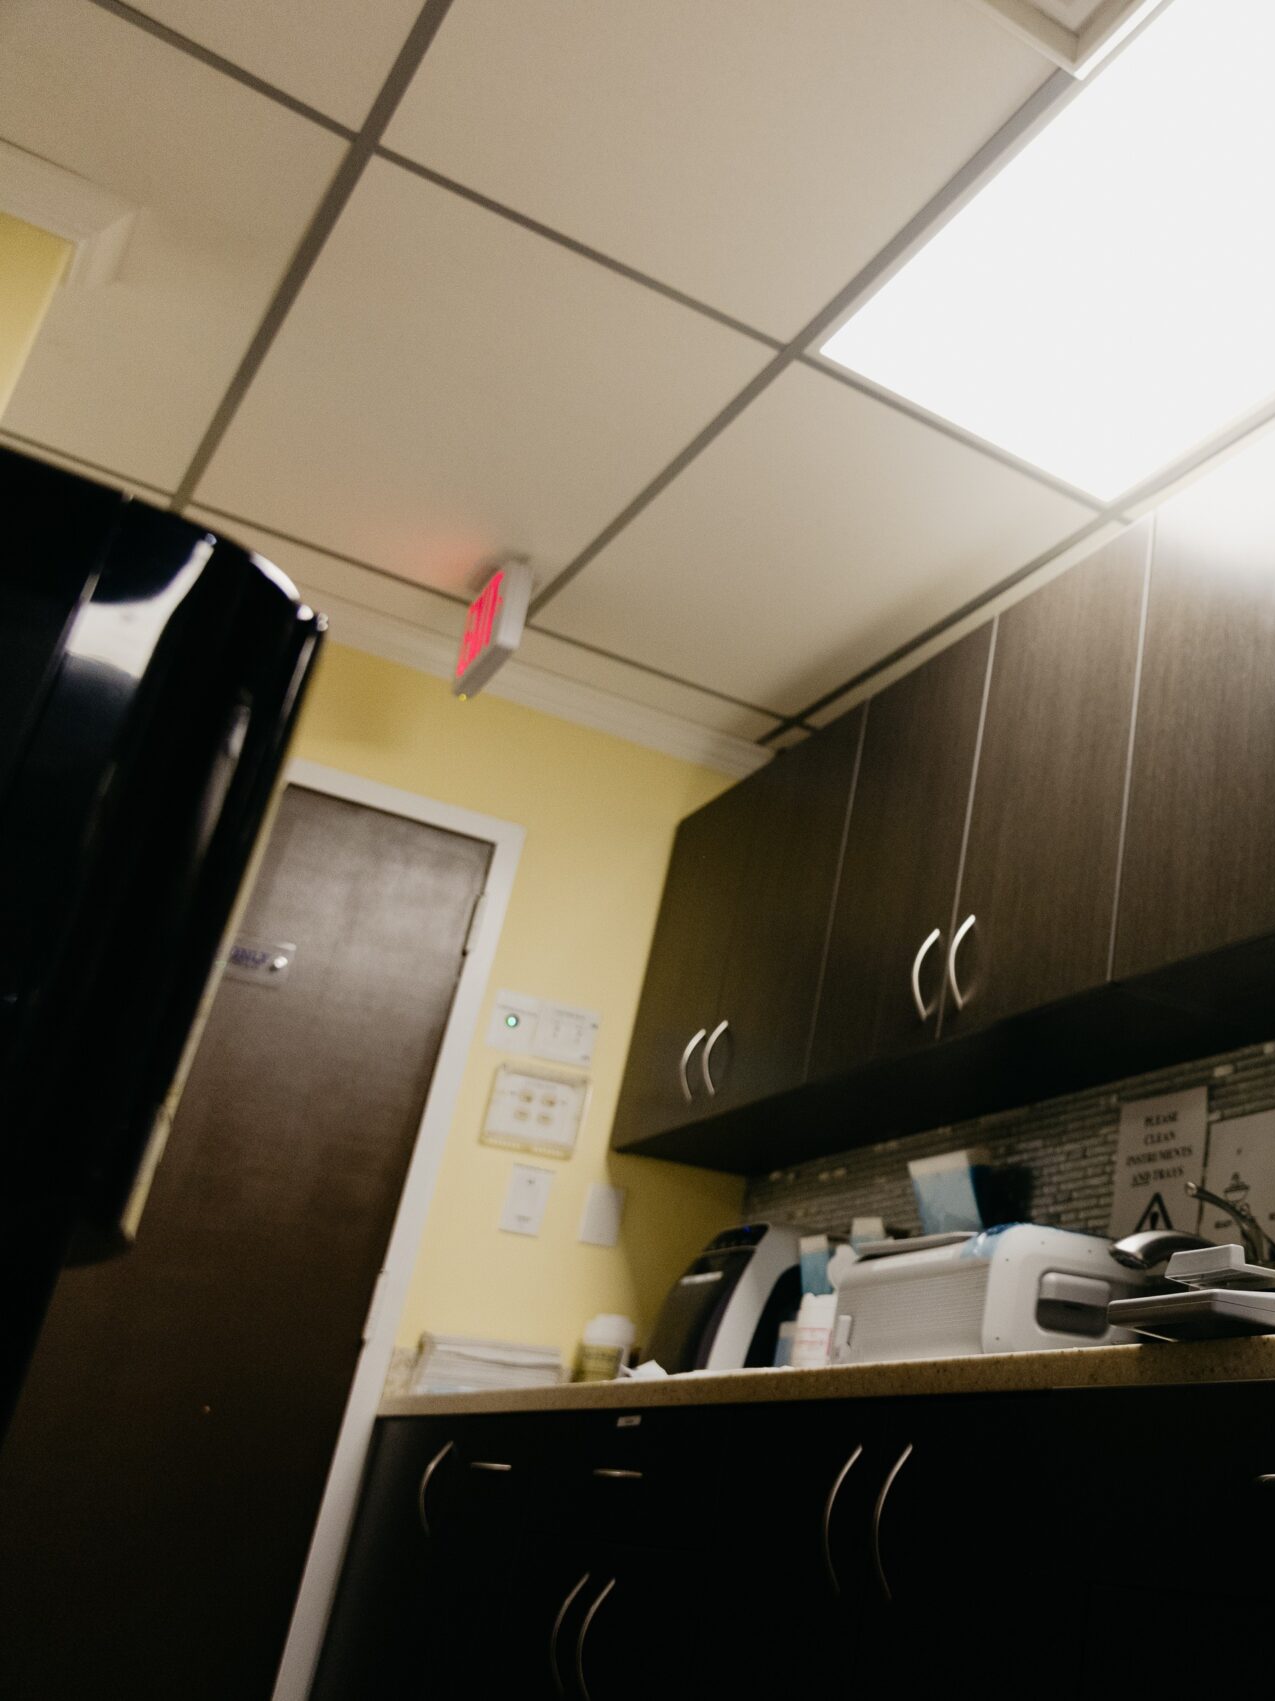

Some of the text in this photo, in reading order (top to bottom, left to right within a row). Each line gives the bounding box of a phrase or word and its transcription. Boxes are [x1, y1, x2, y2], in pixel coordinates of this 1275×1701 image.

[1144, 1111, 1178, 1127] PLEASE
[1144, 1131, 1176, 1146] CLEAN
[1126, 1146, 1193, 1166] INSTRUMENTS
[1132, 1167, 1183, 1185] AND TRAYS
